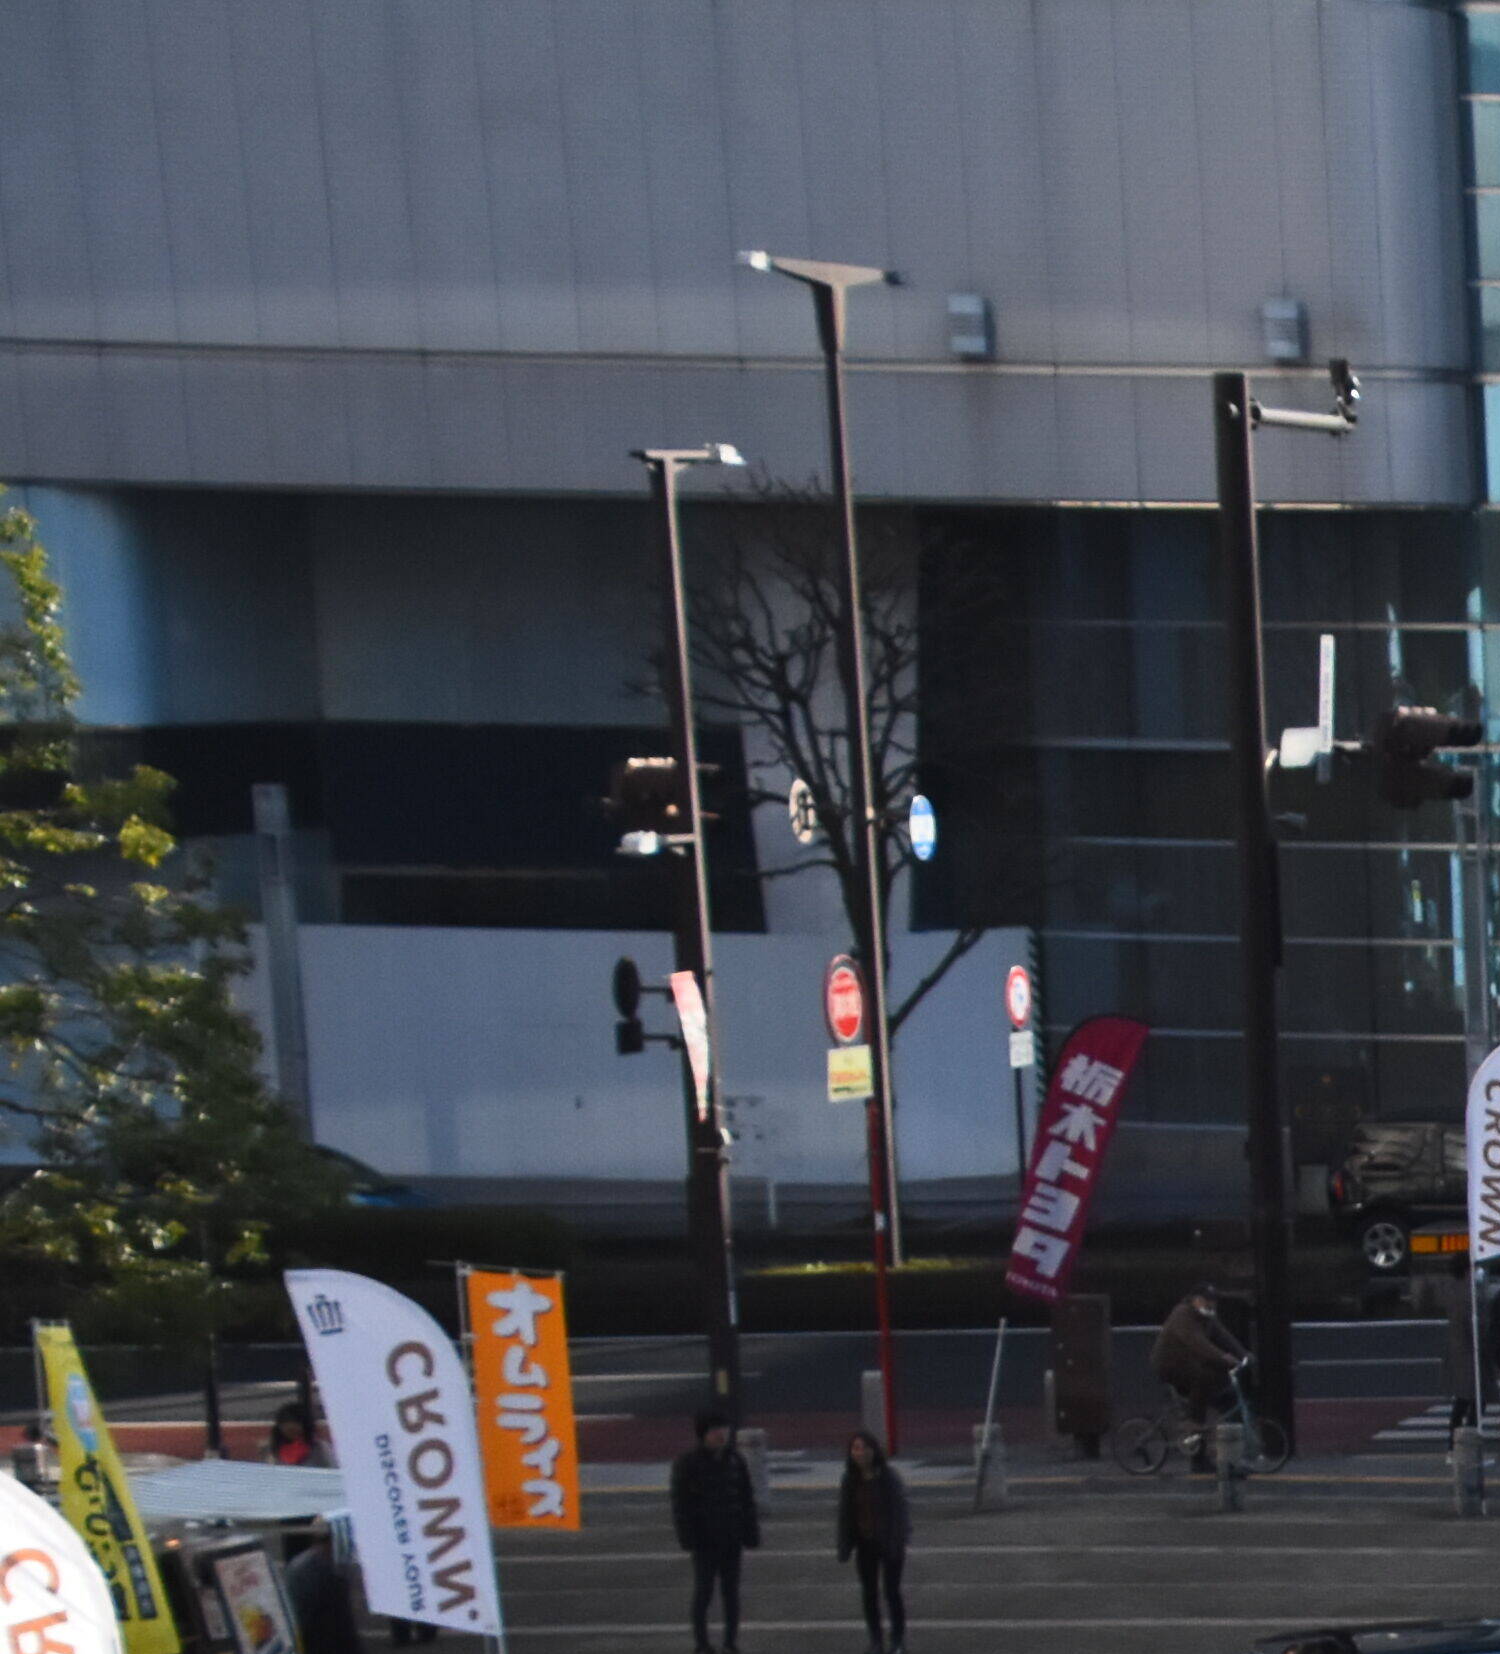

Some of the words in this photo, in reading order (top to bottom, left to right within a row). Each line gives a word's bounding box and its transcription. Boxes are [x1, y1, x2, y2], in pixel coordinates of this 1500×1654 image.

[1012, 1053, 1125, 1279] 栃木トヨタ
[486, 1281, 566, 1519] オムライス
